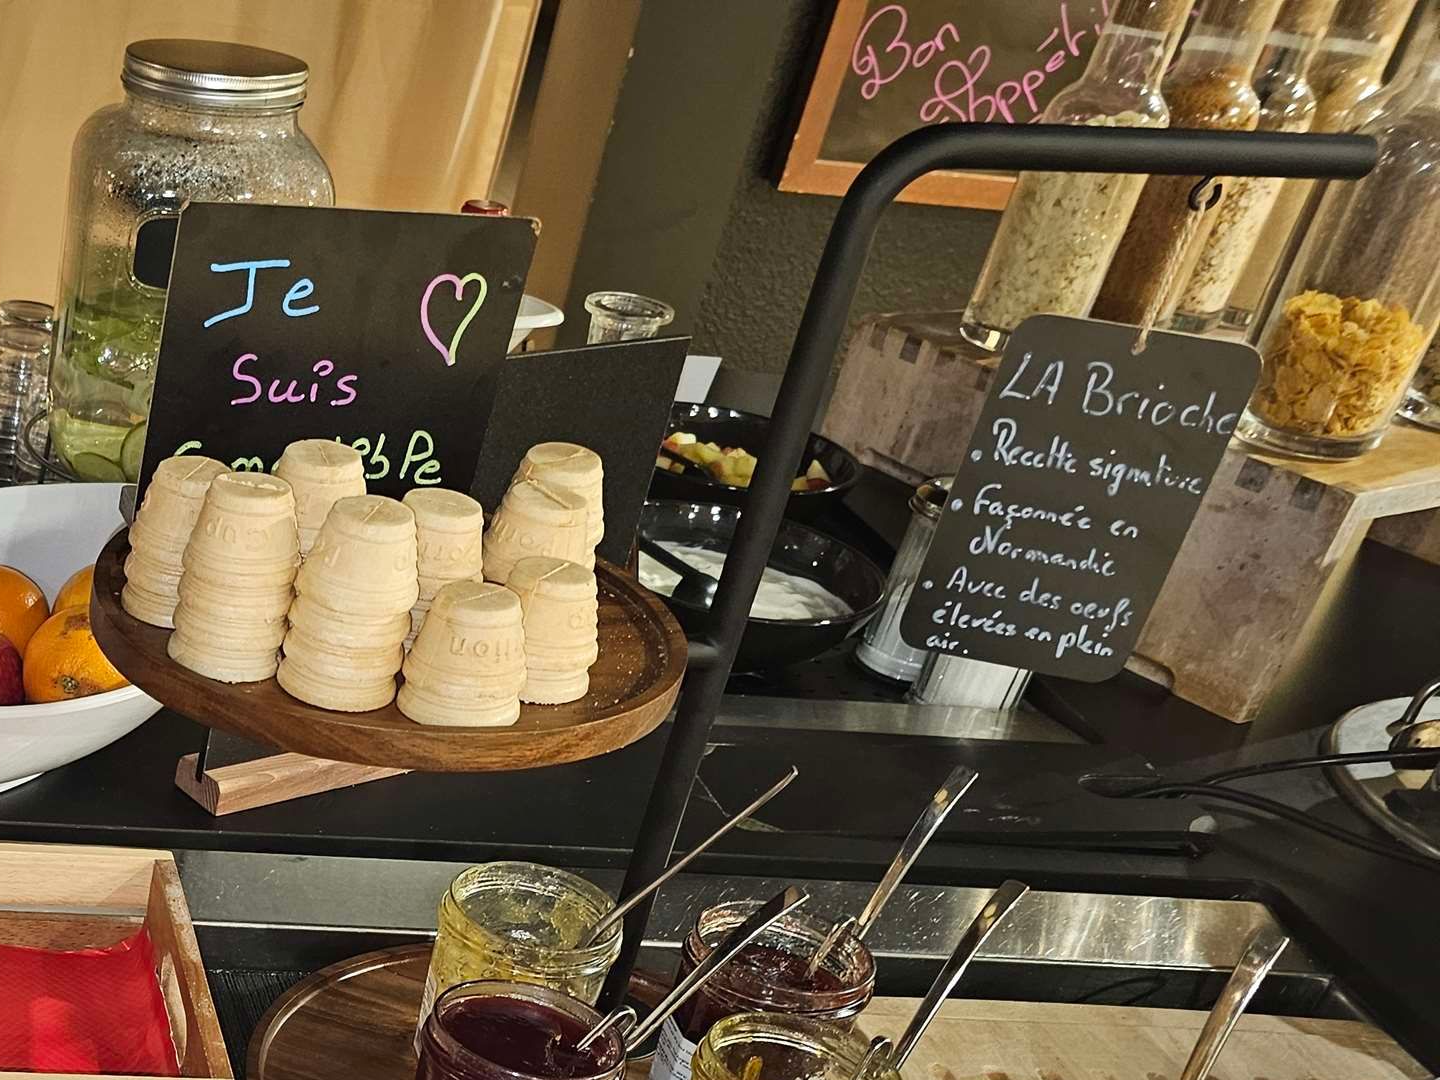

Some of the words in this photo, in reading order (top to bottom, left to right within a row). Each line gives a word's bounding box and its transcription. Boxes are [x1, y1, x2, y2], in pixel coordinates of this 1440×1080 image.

[852, 4, 960, 100] Bon
[203, 258, 320, 328] Je
[230, 353, 359, 406] Suis
[998, 352, 1064, 405] LA
[973, 483, 1092, 529] Façonnée
[1110, 520, 1139, 539] en
[968, 525, 1116, 577] Normandie
[946, 565, 1007, 599] Avec
[1018, 576, 1062, 610] des
[1024, 627, 1052, 642] en
[1055, 624, 1114, 659] plein
